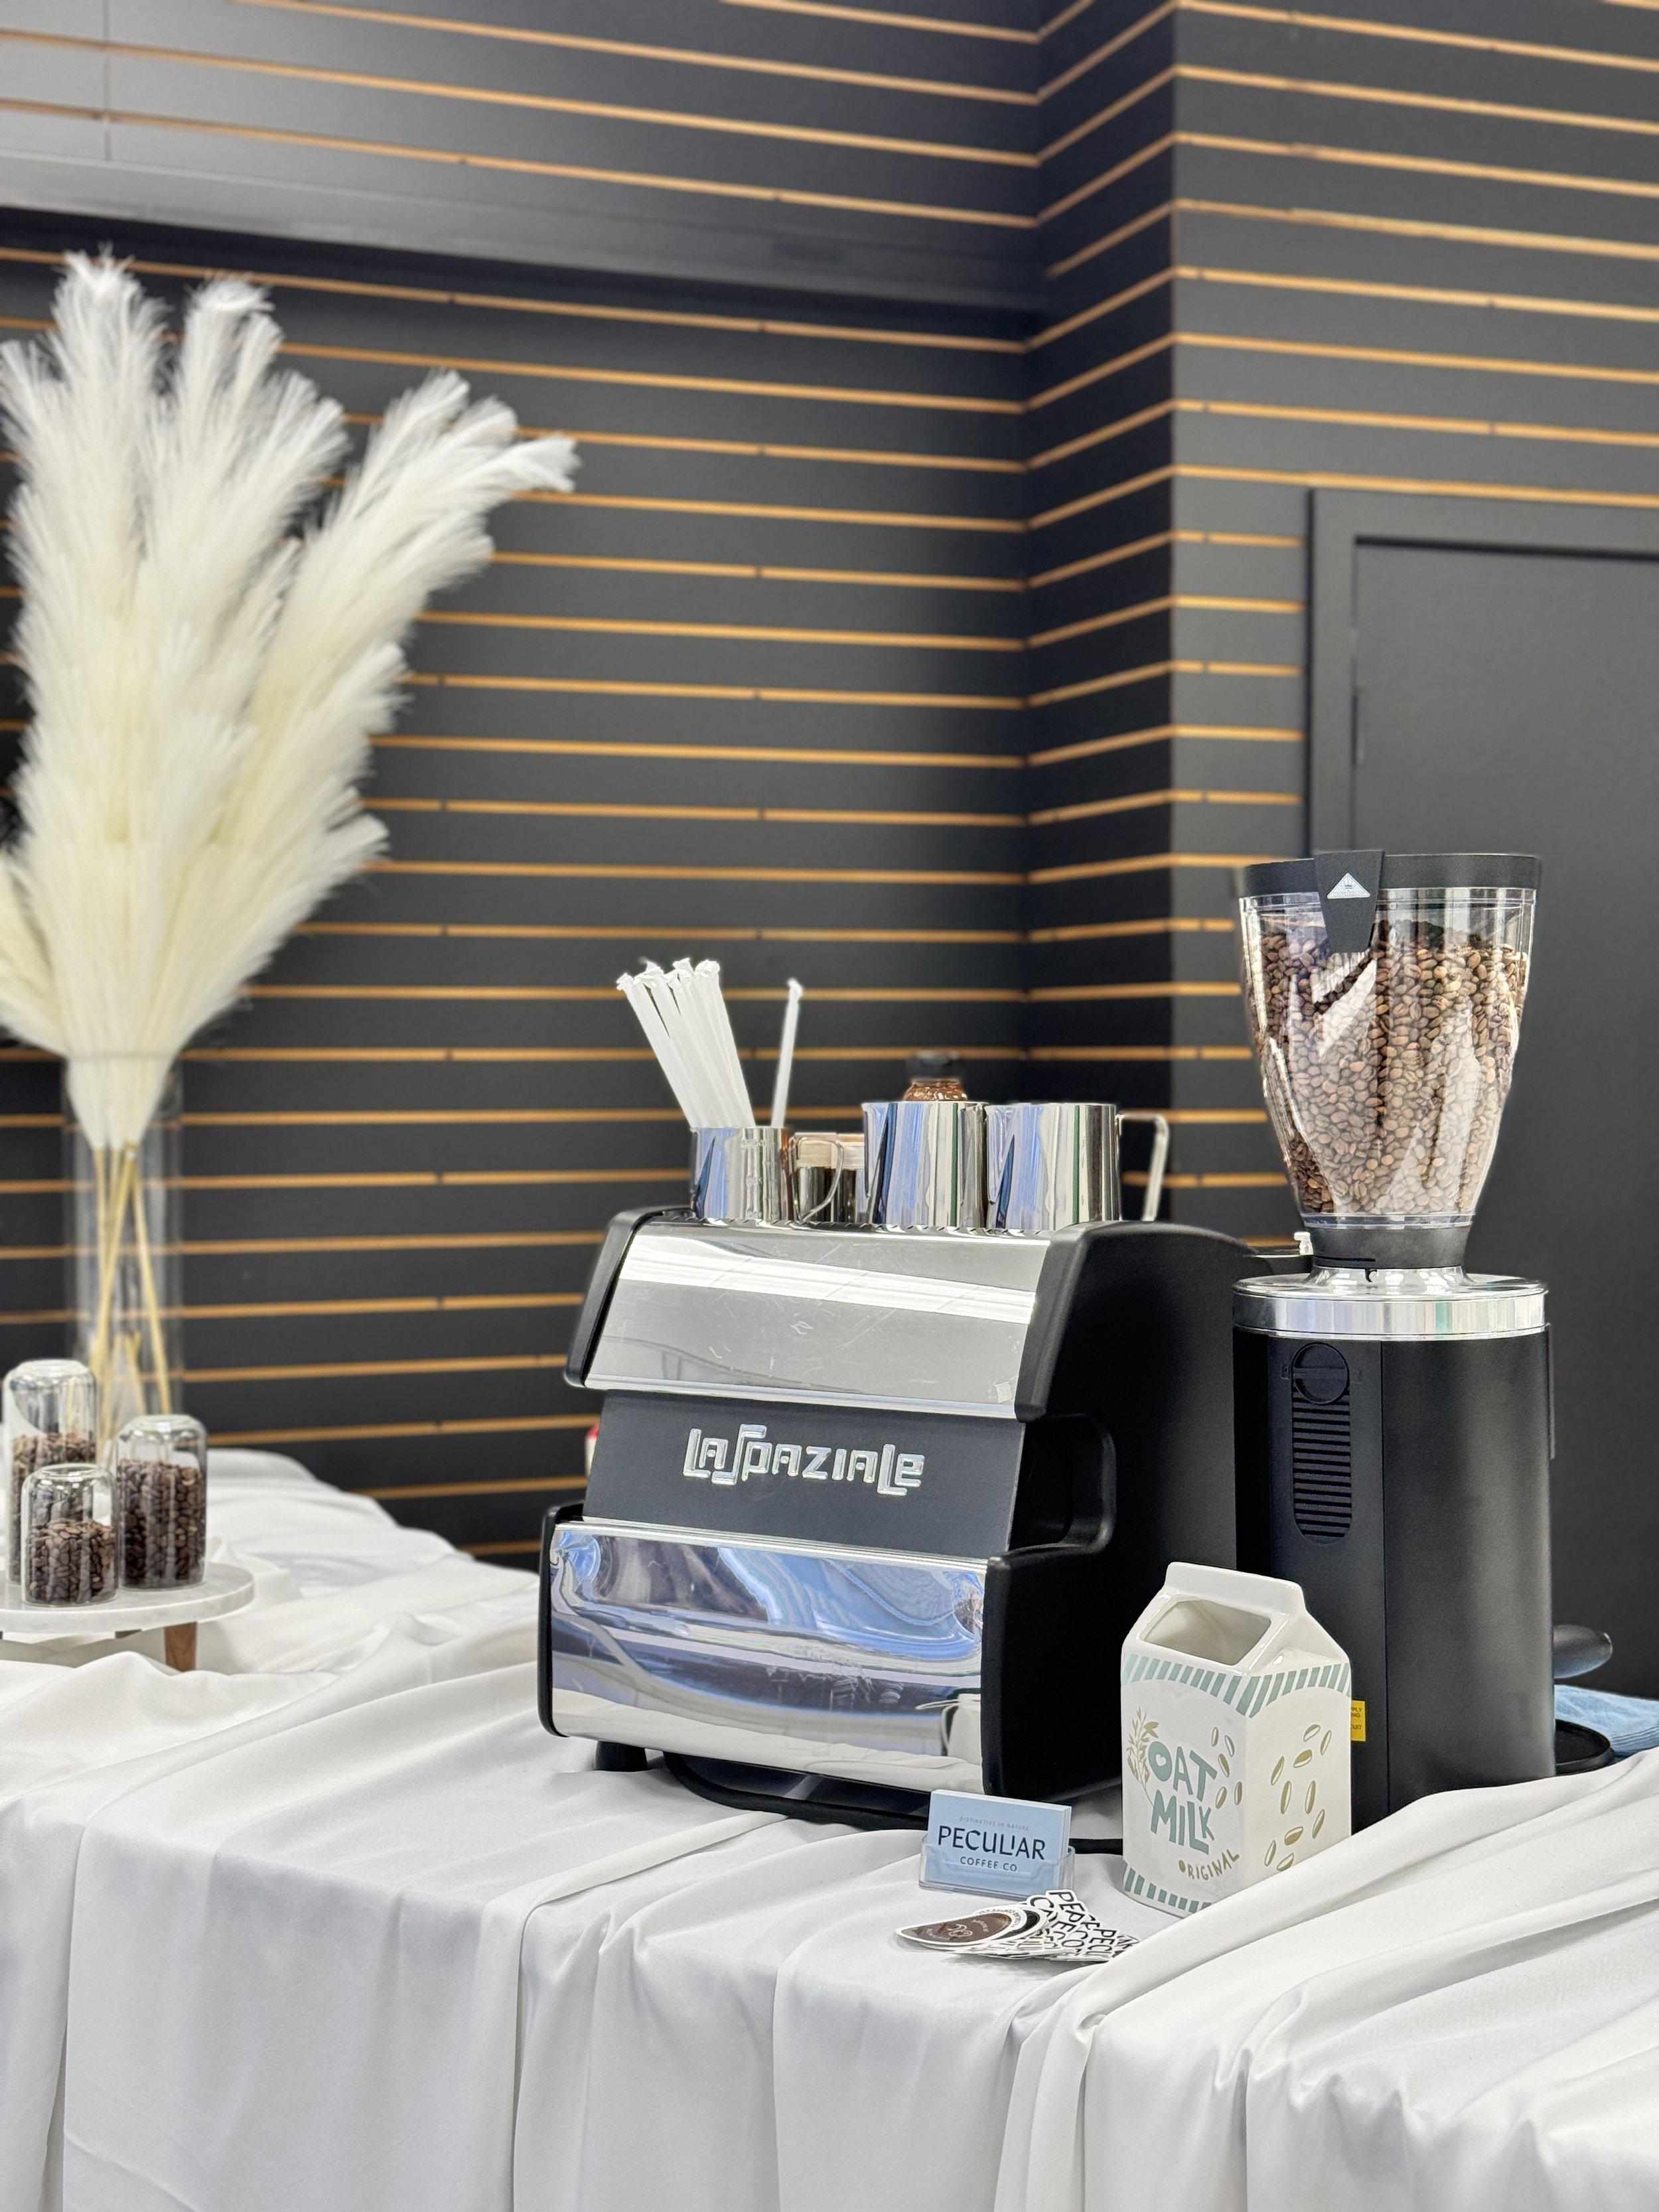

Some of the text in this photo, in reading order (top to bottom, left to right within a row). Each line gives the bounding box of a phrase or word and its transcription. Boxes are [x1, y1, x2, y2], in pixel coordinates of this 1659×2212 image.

[1148, 1741, 1218, 1803] OAT
[959, 1816, 995, 1826] DISTINCTIVE
[1007, 1823, 1029, 1832] NATURE
[1150, 1789, 1215, 1856] MILK
[937, 1824, 1046, 1860] PECULIAR
[960, 1856, 999, 1870] COFFEE
[1178, 1849, 1240, 1881] ORIGINAL
